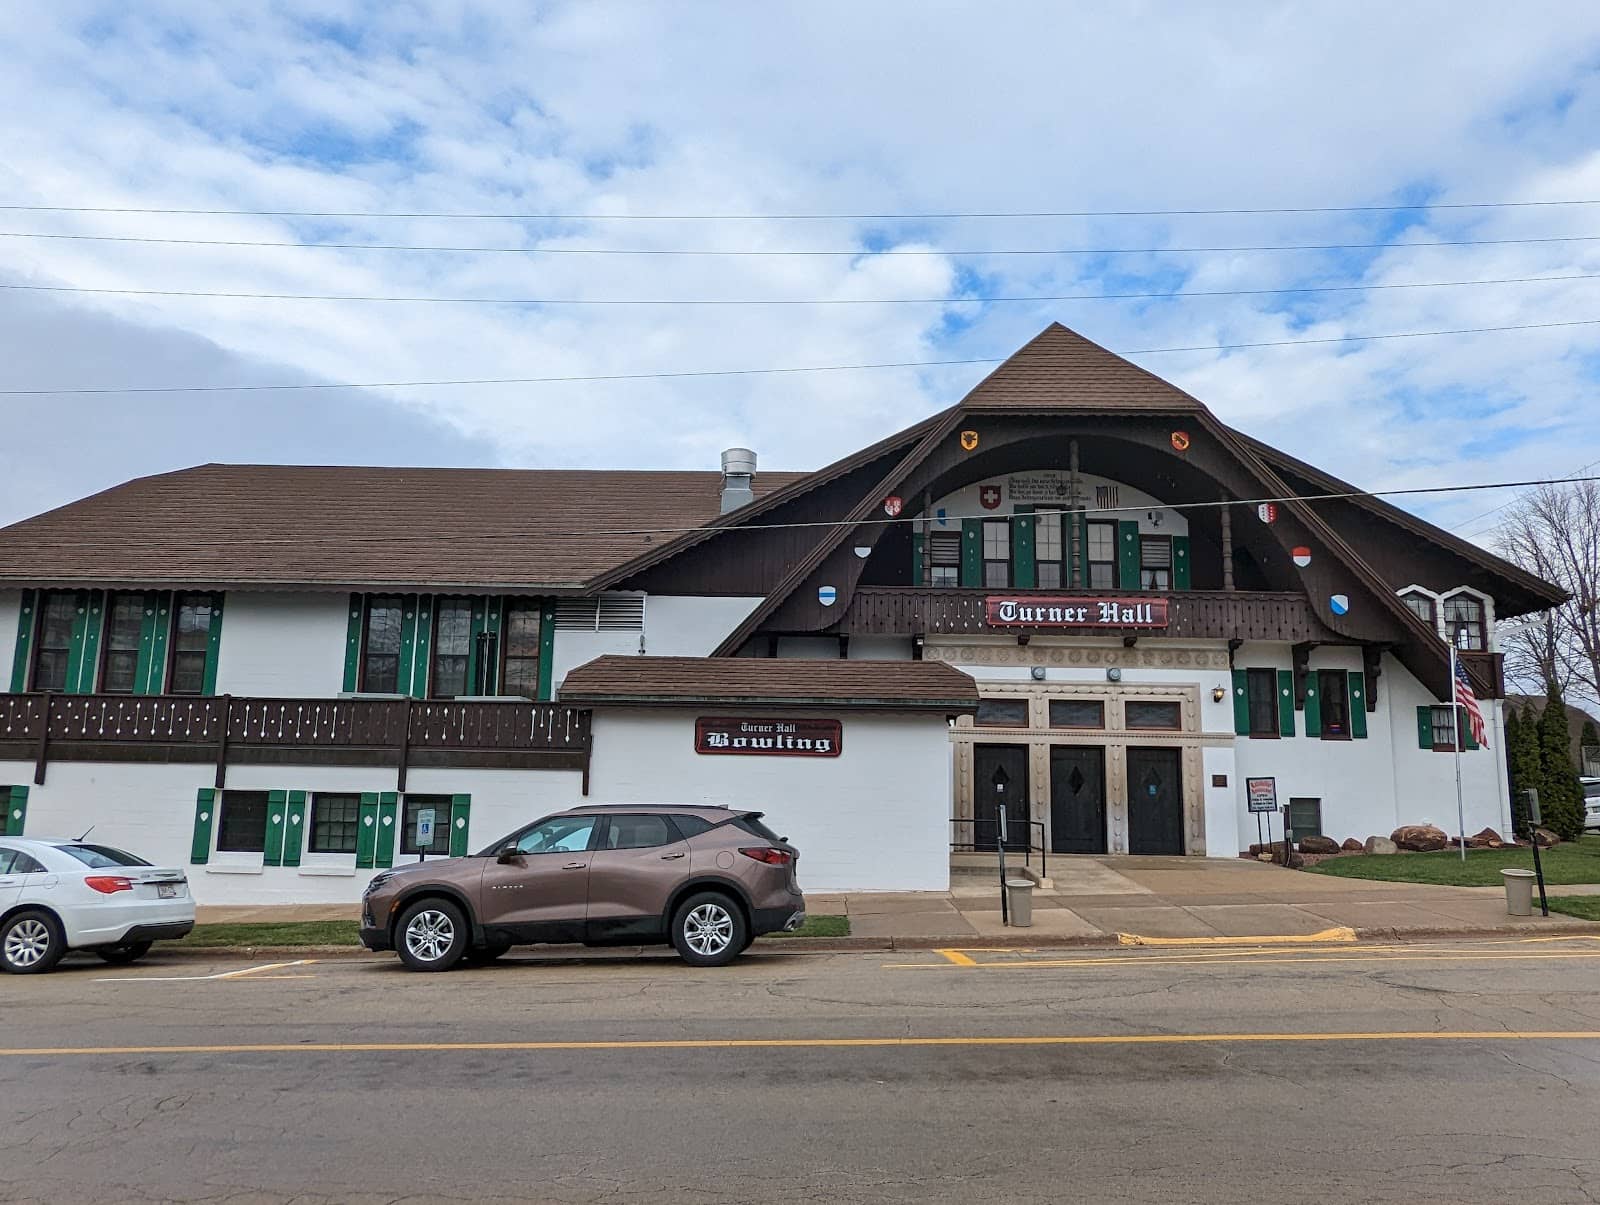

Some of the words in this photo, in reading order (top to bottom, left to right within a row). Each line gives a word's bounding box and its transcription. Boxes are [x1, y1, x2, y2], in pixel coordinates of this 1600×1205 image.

[999, 601, 1088, 622] Turner
[1097, 602, 1153, 623] Hall
[741, 722, 773, 732] Turner
[776, 723, 796, 733] Hall
[706, 732, 830, 752] Bowling
